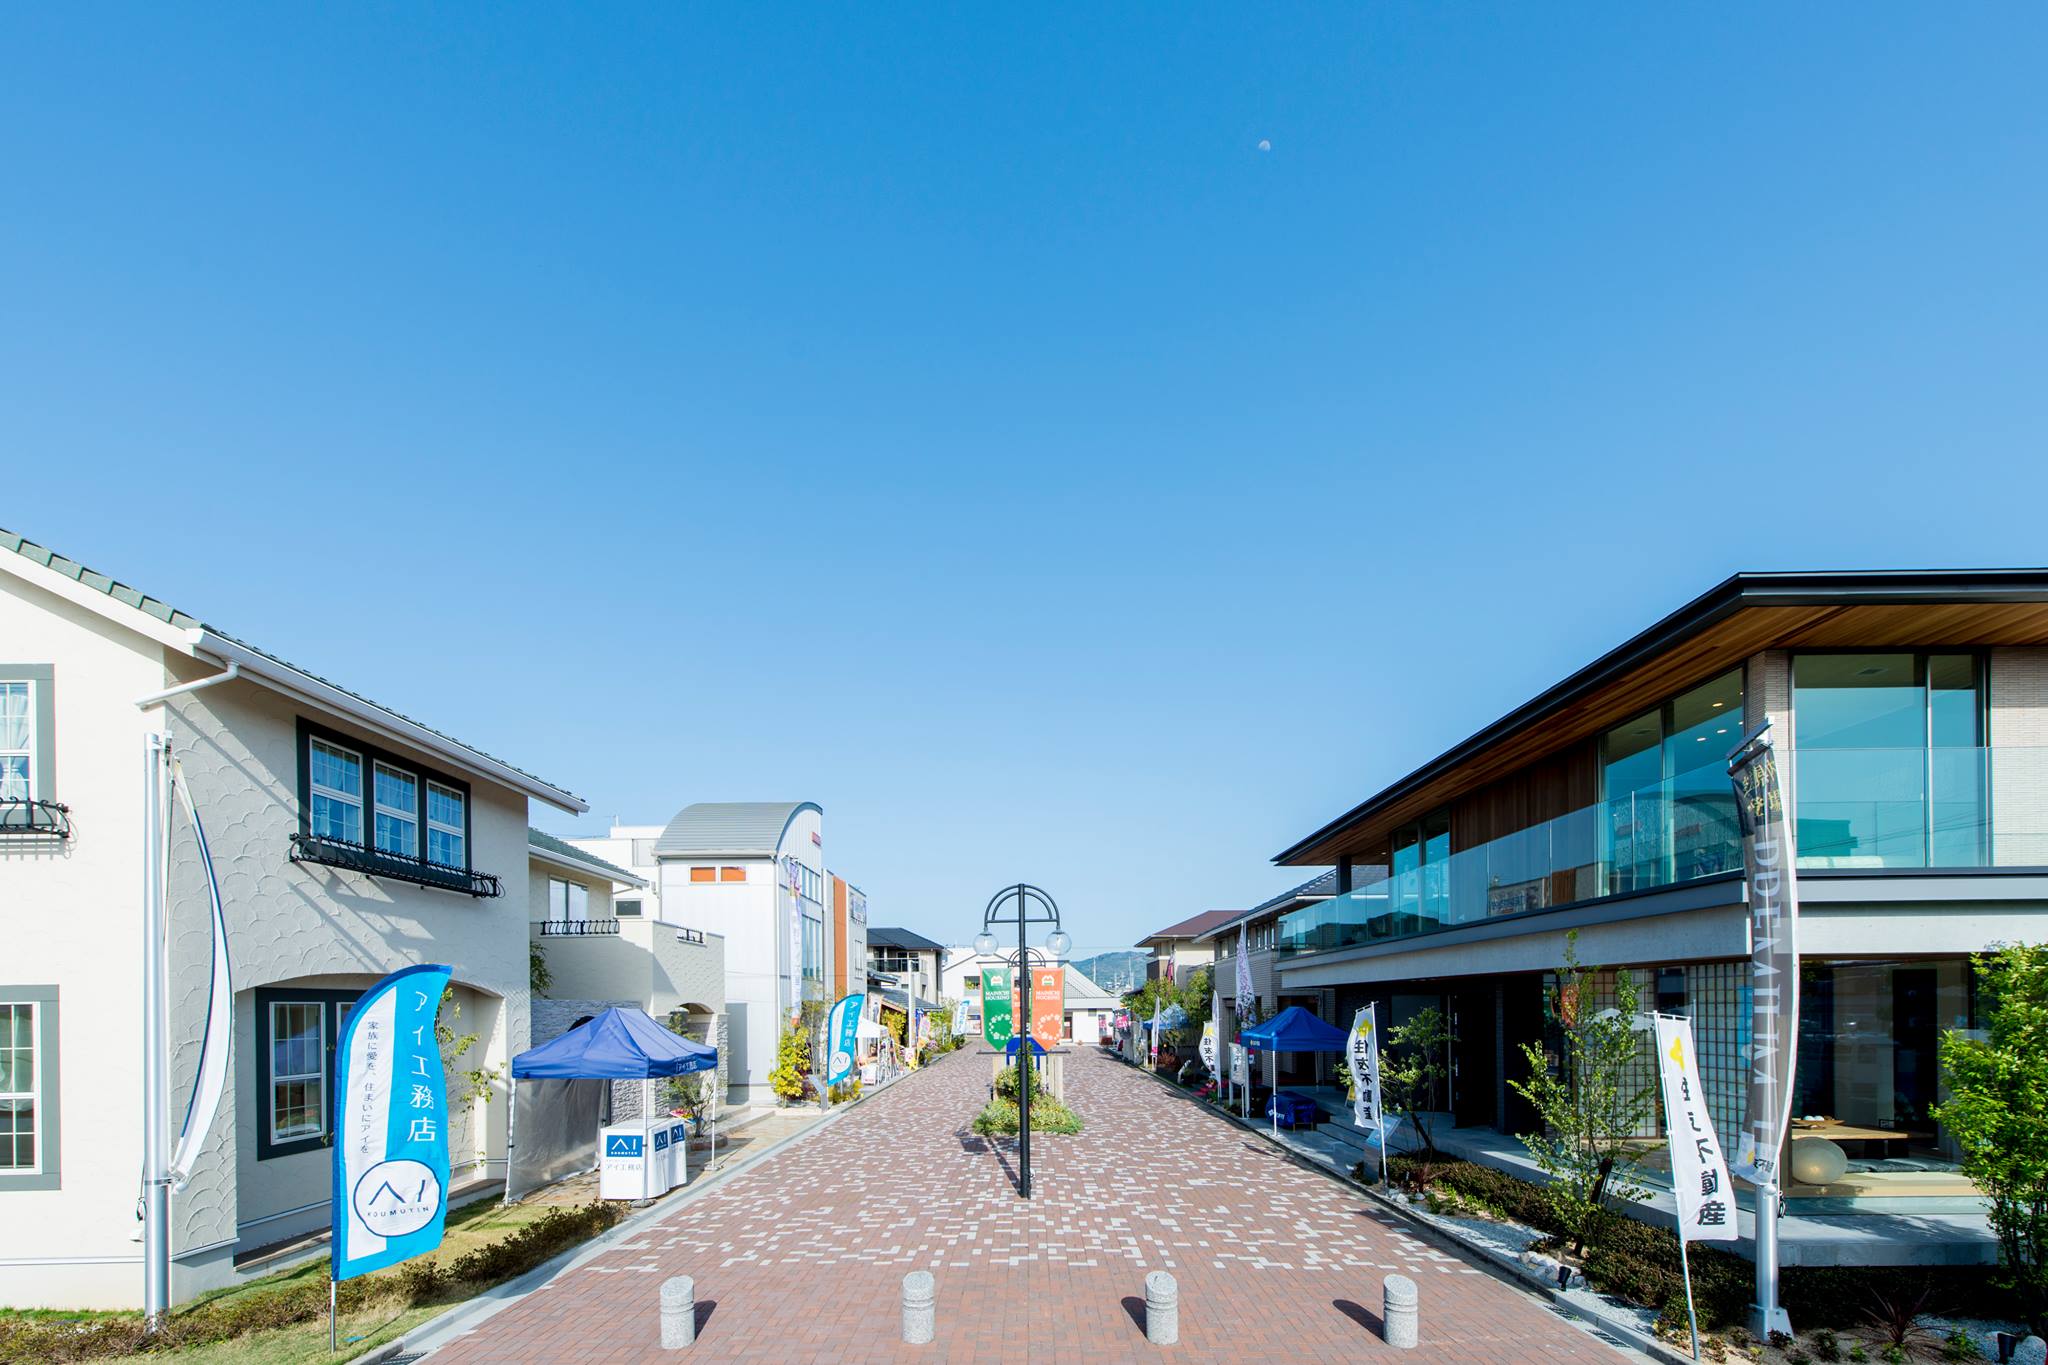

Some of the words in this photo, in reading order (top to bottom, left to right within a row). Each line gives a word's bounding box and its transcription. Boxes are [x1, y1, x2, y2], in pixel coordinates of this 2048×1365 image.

[407, 991, 437, 1142] アイ工務店
[611, 1138, 637, 1150] AI
[368, 1179, 426, 1206] AI
